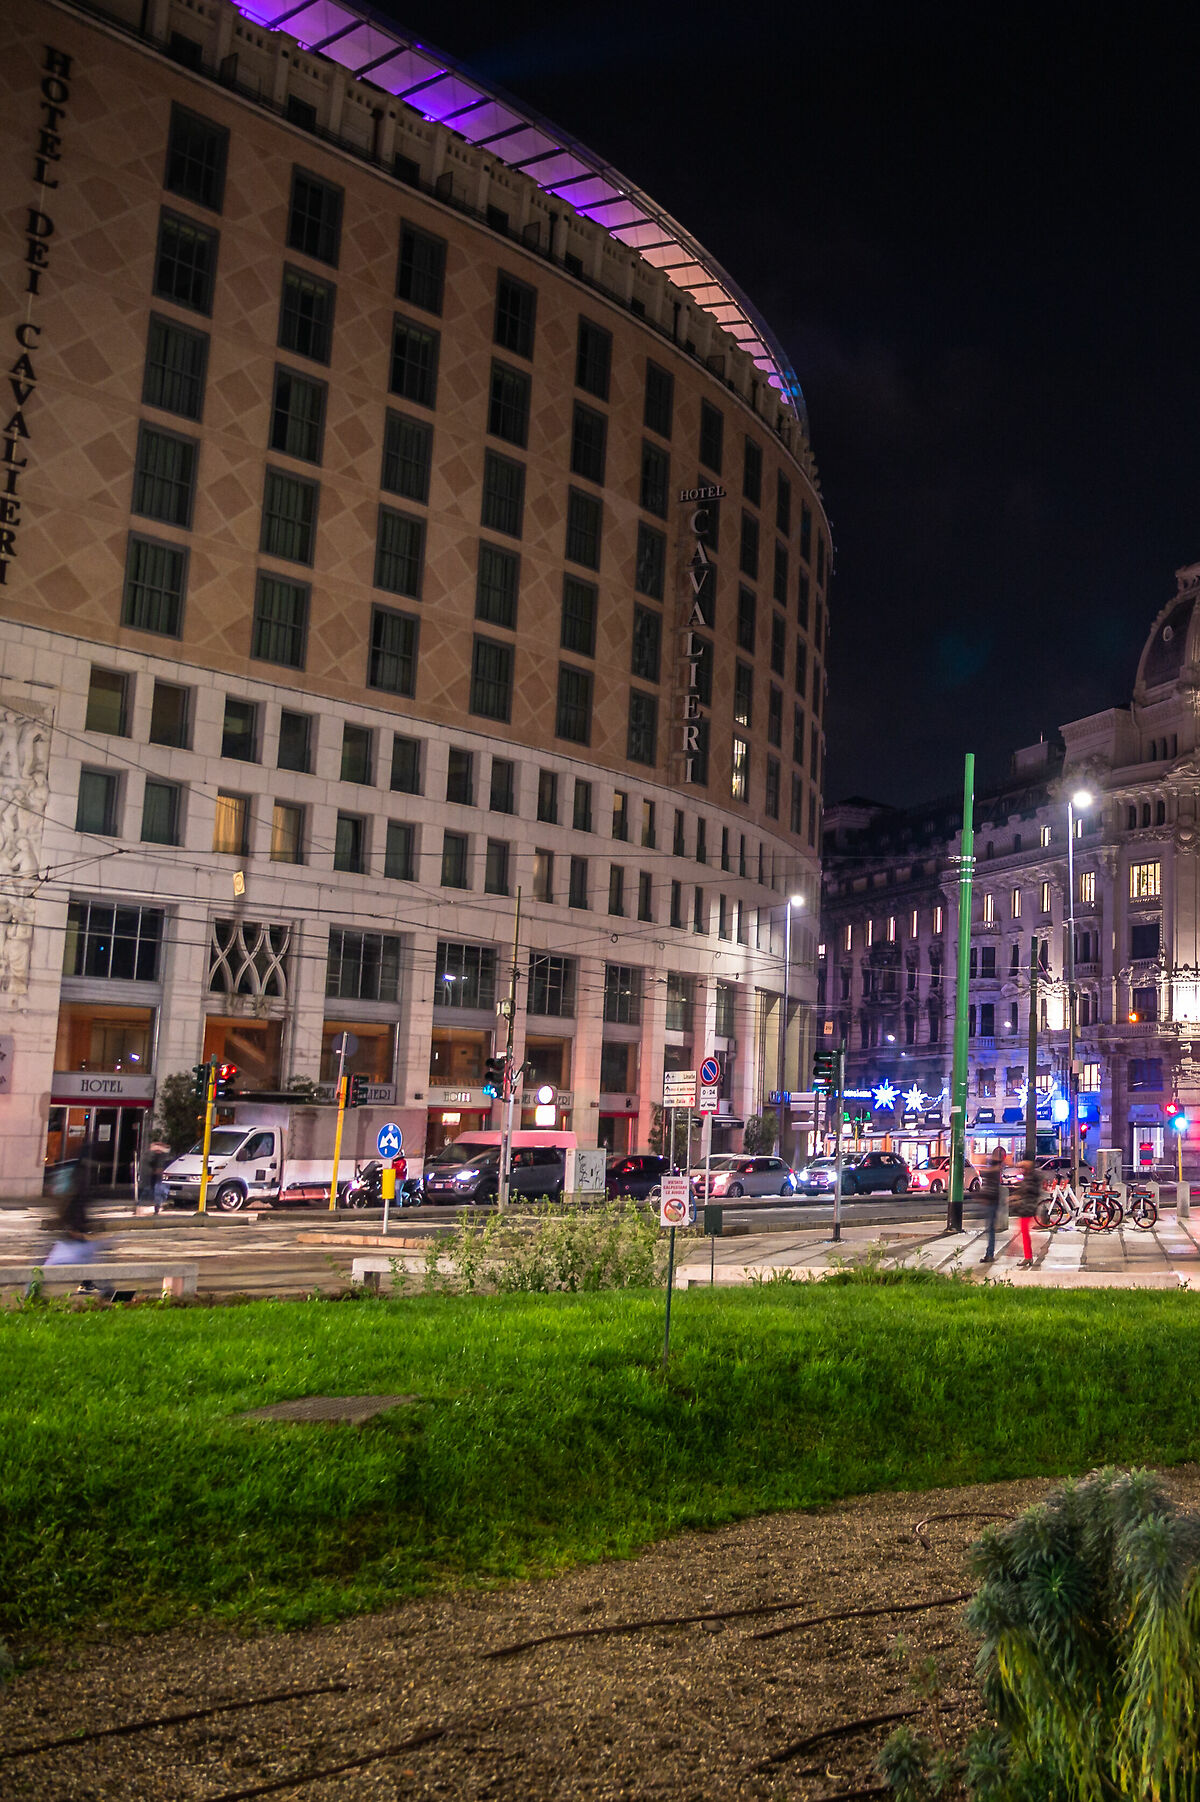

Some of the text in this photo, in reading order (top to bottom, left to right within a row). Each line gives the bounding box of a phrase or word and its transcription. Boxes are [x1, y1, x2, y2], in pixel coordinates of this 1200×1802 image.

[0, 45, 74, 585] HOTEL DEI CAVALIERI
[680, 485, 725, 501] HOTEL
[682, 509, 711, 783] CAVALIERI
[81, 1080, 123, 1093] HOTEL
